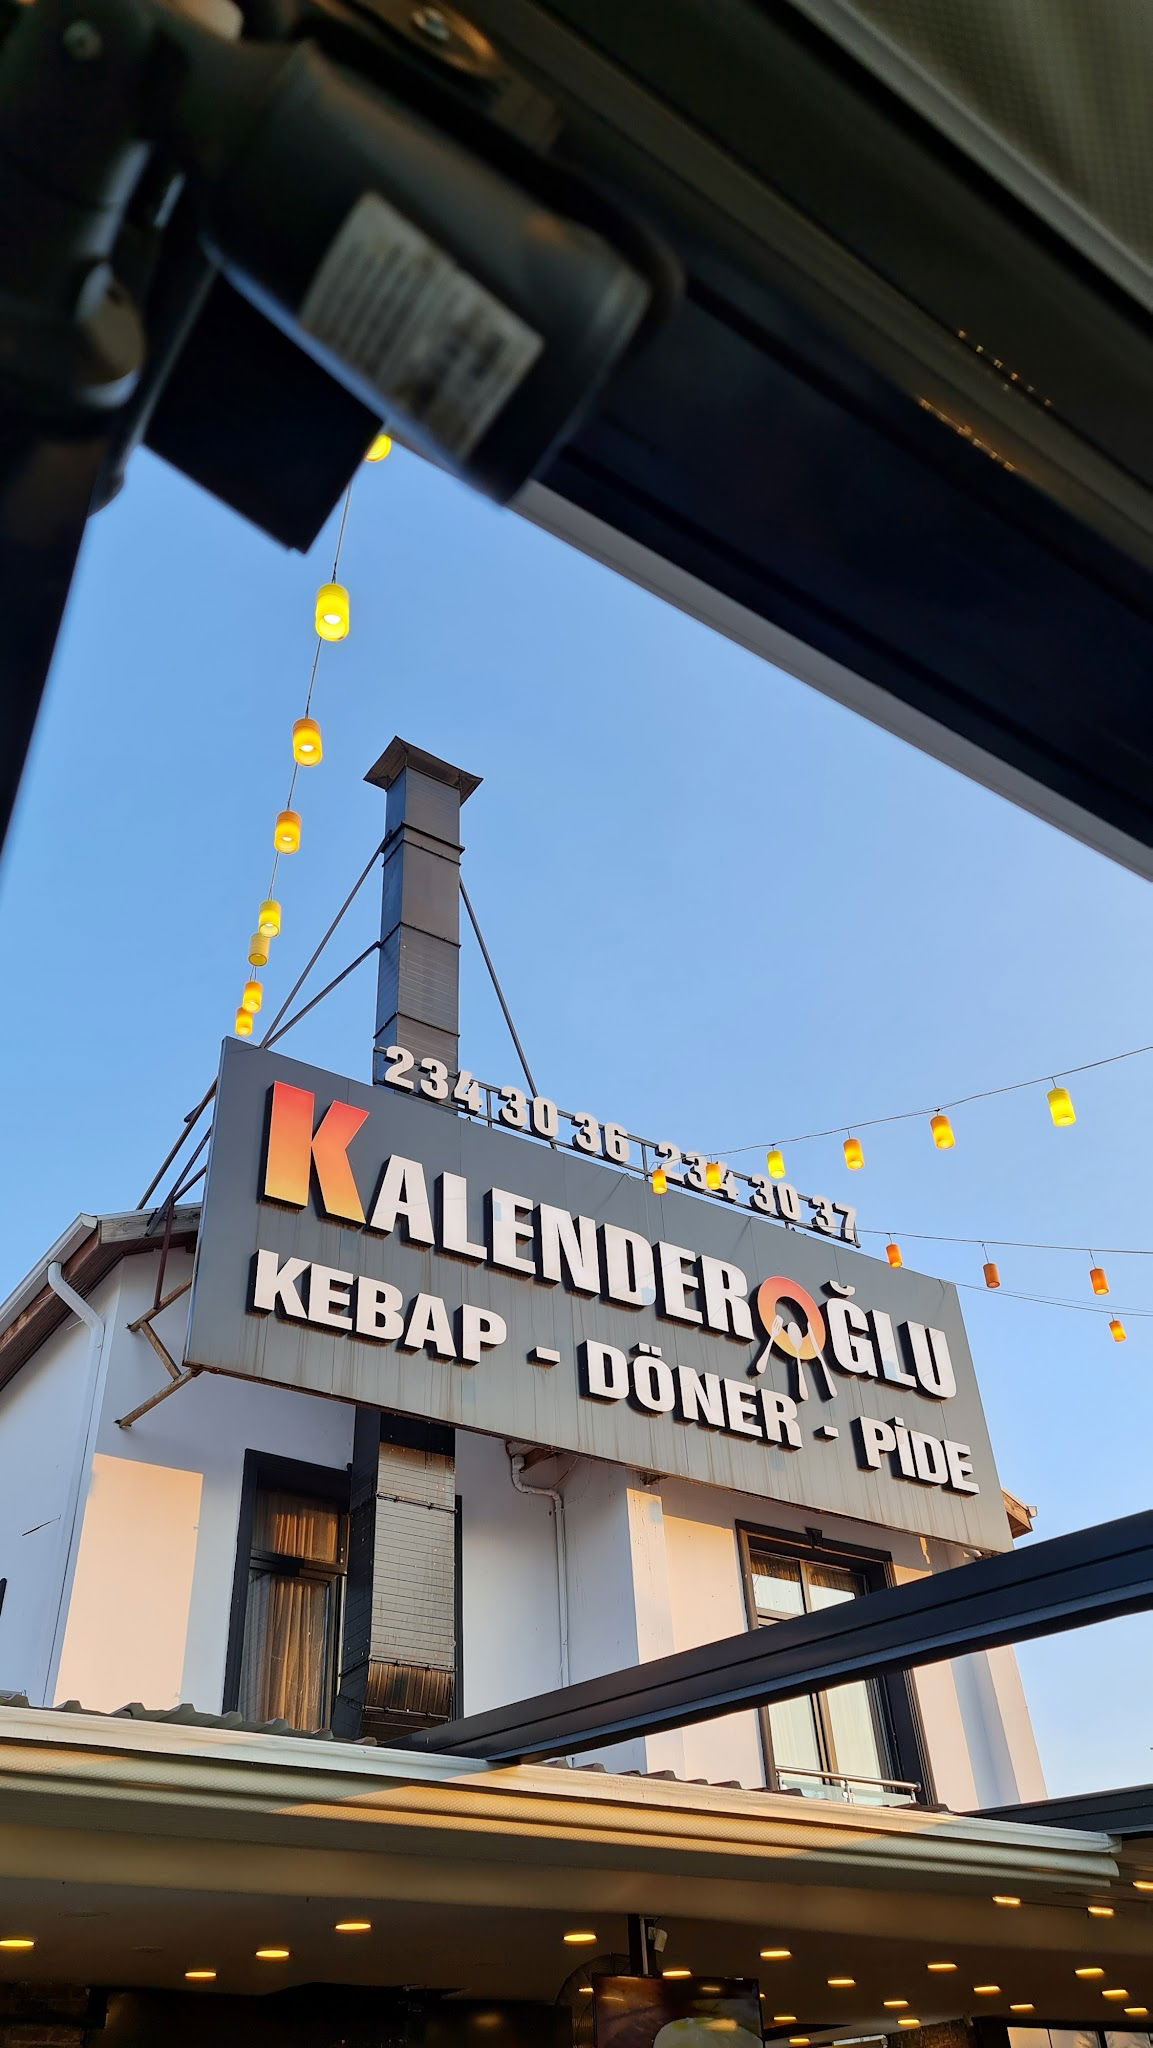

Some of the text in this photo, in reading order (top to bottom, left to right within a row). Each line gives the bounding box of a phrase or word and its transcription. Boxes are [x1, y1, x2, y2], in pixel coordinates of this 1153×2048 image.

[263, 1080, 957, 1400] KALENDEROĞLU
[383, 1045, 858, 1243] 234 30 36 234 30 37
[251, 1249, 981, 1496] KEBAP - DÖNER - PİDE
